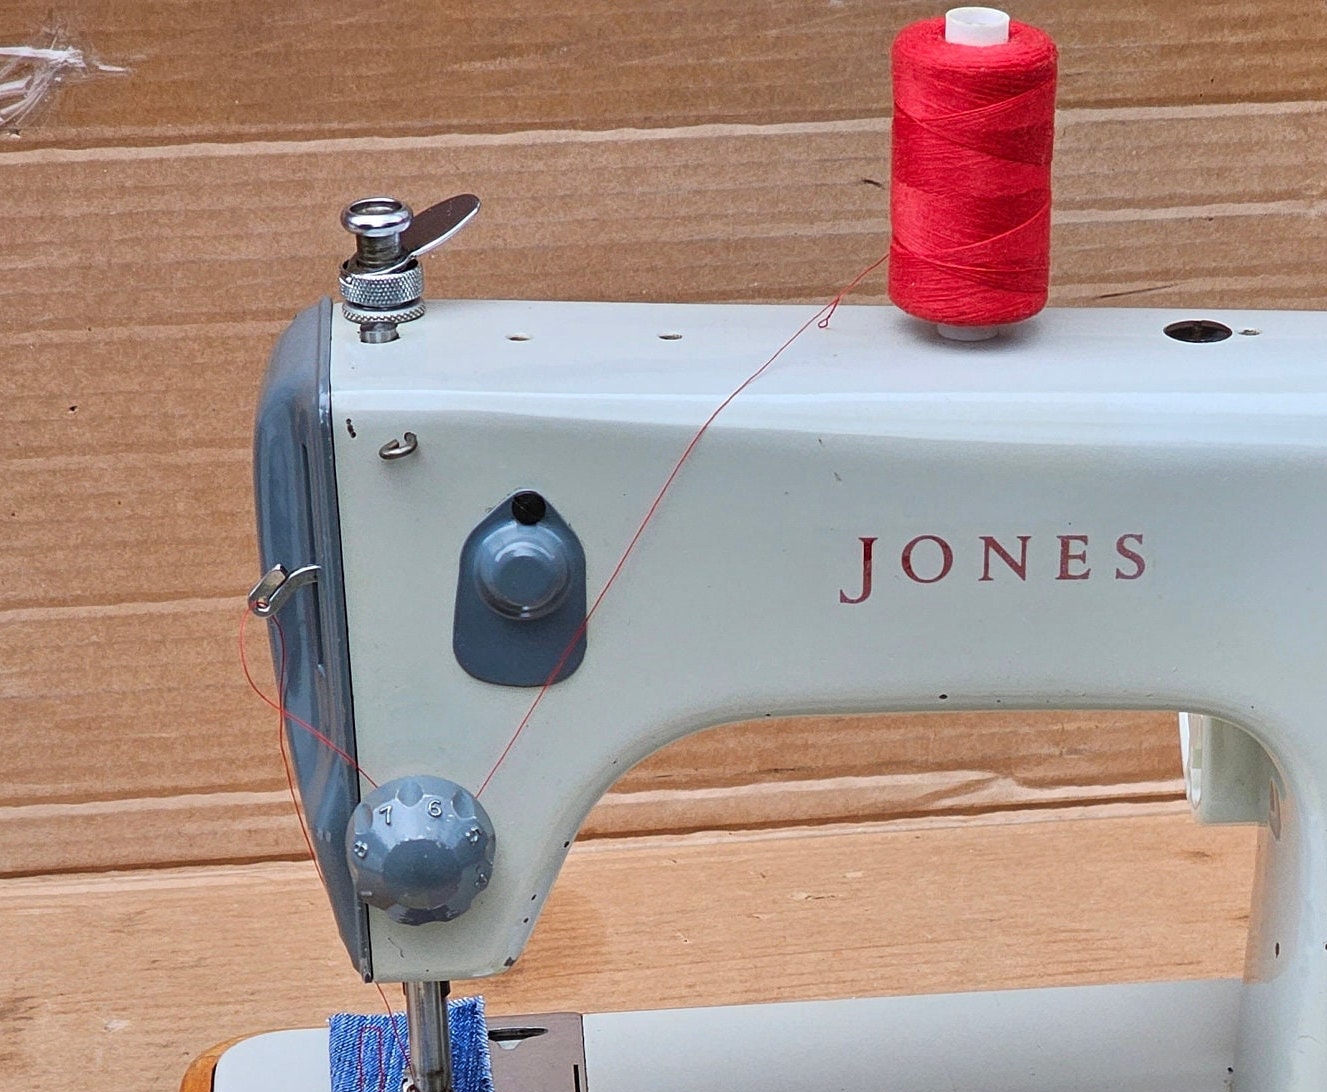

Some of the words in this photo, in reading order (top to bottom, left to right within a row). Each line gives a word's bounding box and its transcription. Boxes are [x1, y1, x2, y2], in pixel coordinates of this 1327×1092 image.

[838, 532, 1147, 605] JONES
[379, 804, 393, 825] 7
[427, 799, 442, 817] 6
